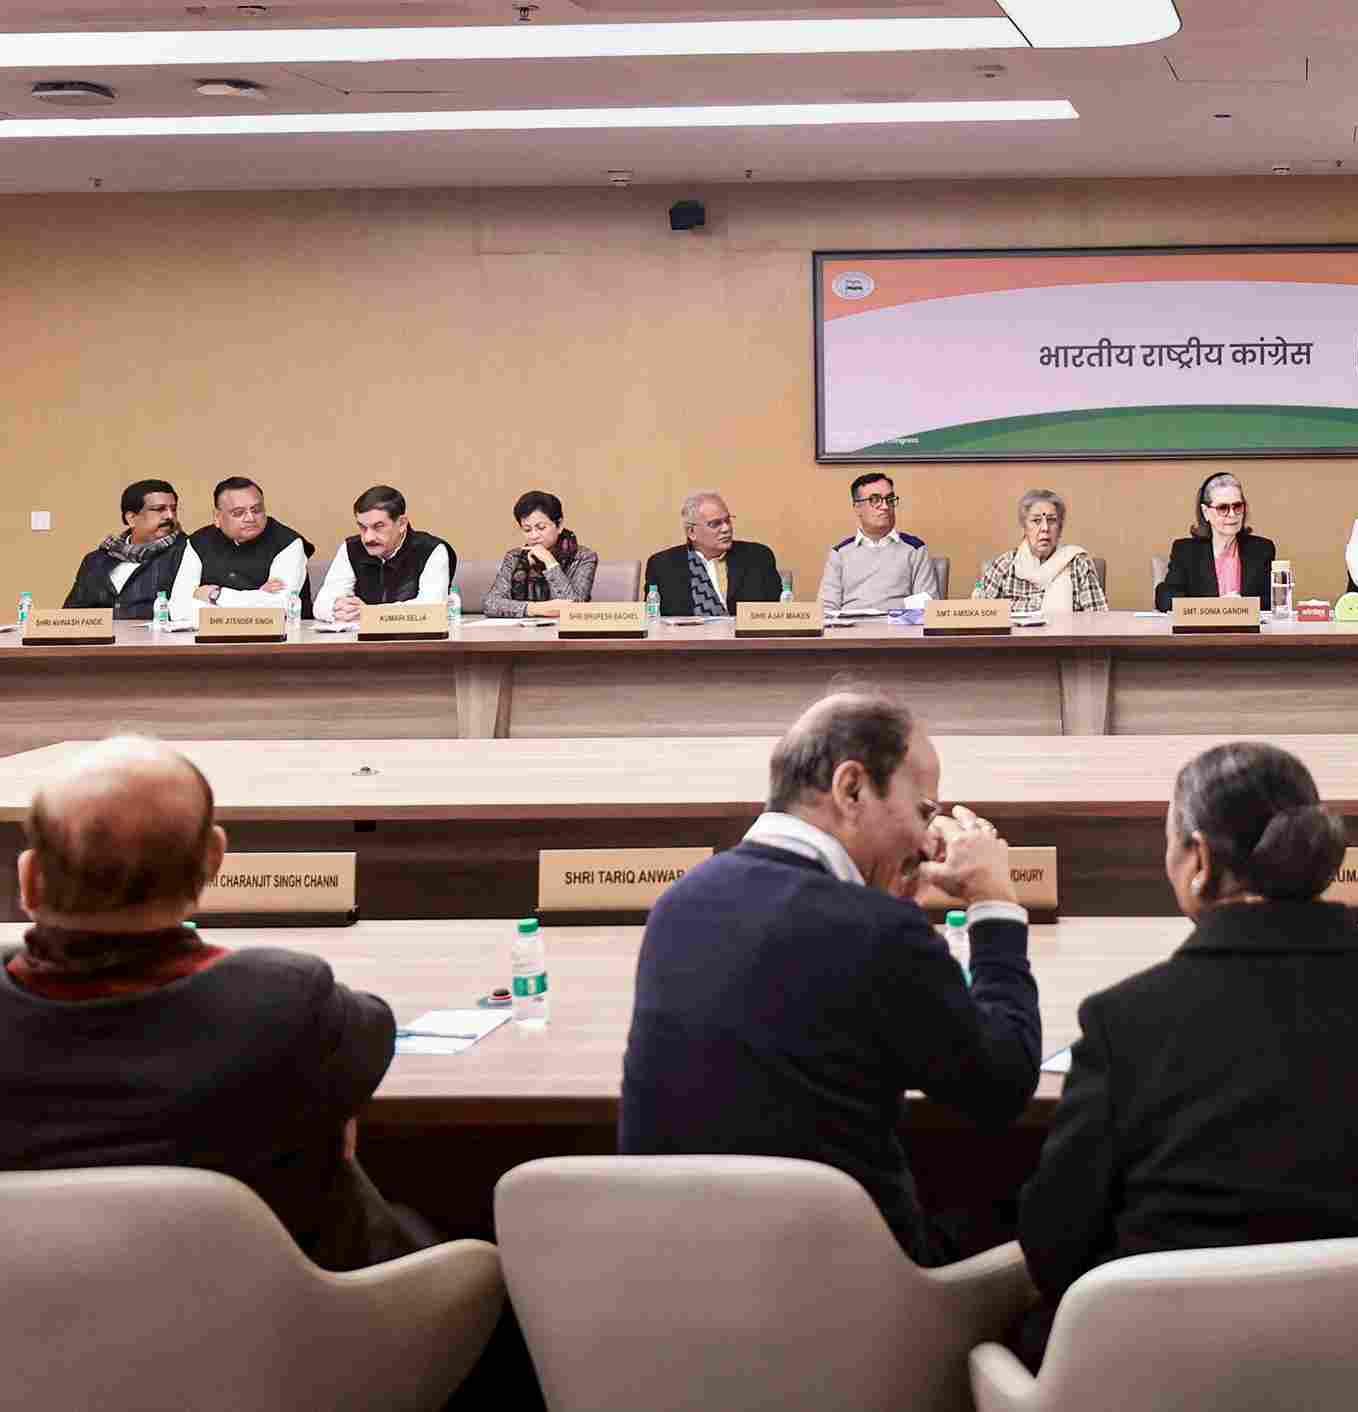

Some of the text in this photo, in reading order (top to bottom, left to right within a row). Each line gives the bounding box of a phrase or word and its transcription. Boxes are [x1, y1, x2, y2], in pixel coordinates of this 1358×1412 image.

[1039, 336, 1314, 369] भारतीय राष्ट्रीय कांग्रेस
[1199, 607, 1221, 616] SONIA
[1222, 607, 1249, 615] GANDHI
[220, 874, 272, 888] CHARANJIT
[273, 874, 302, 888] SINGH
[303, 874, 338, 888] CHANNI
[565, 871, 594, 885] SHRI
[597, 870, 635, 885] TARIQ
[1010, 868, 1044, 882] DHURY
